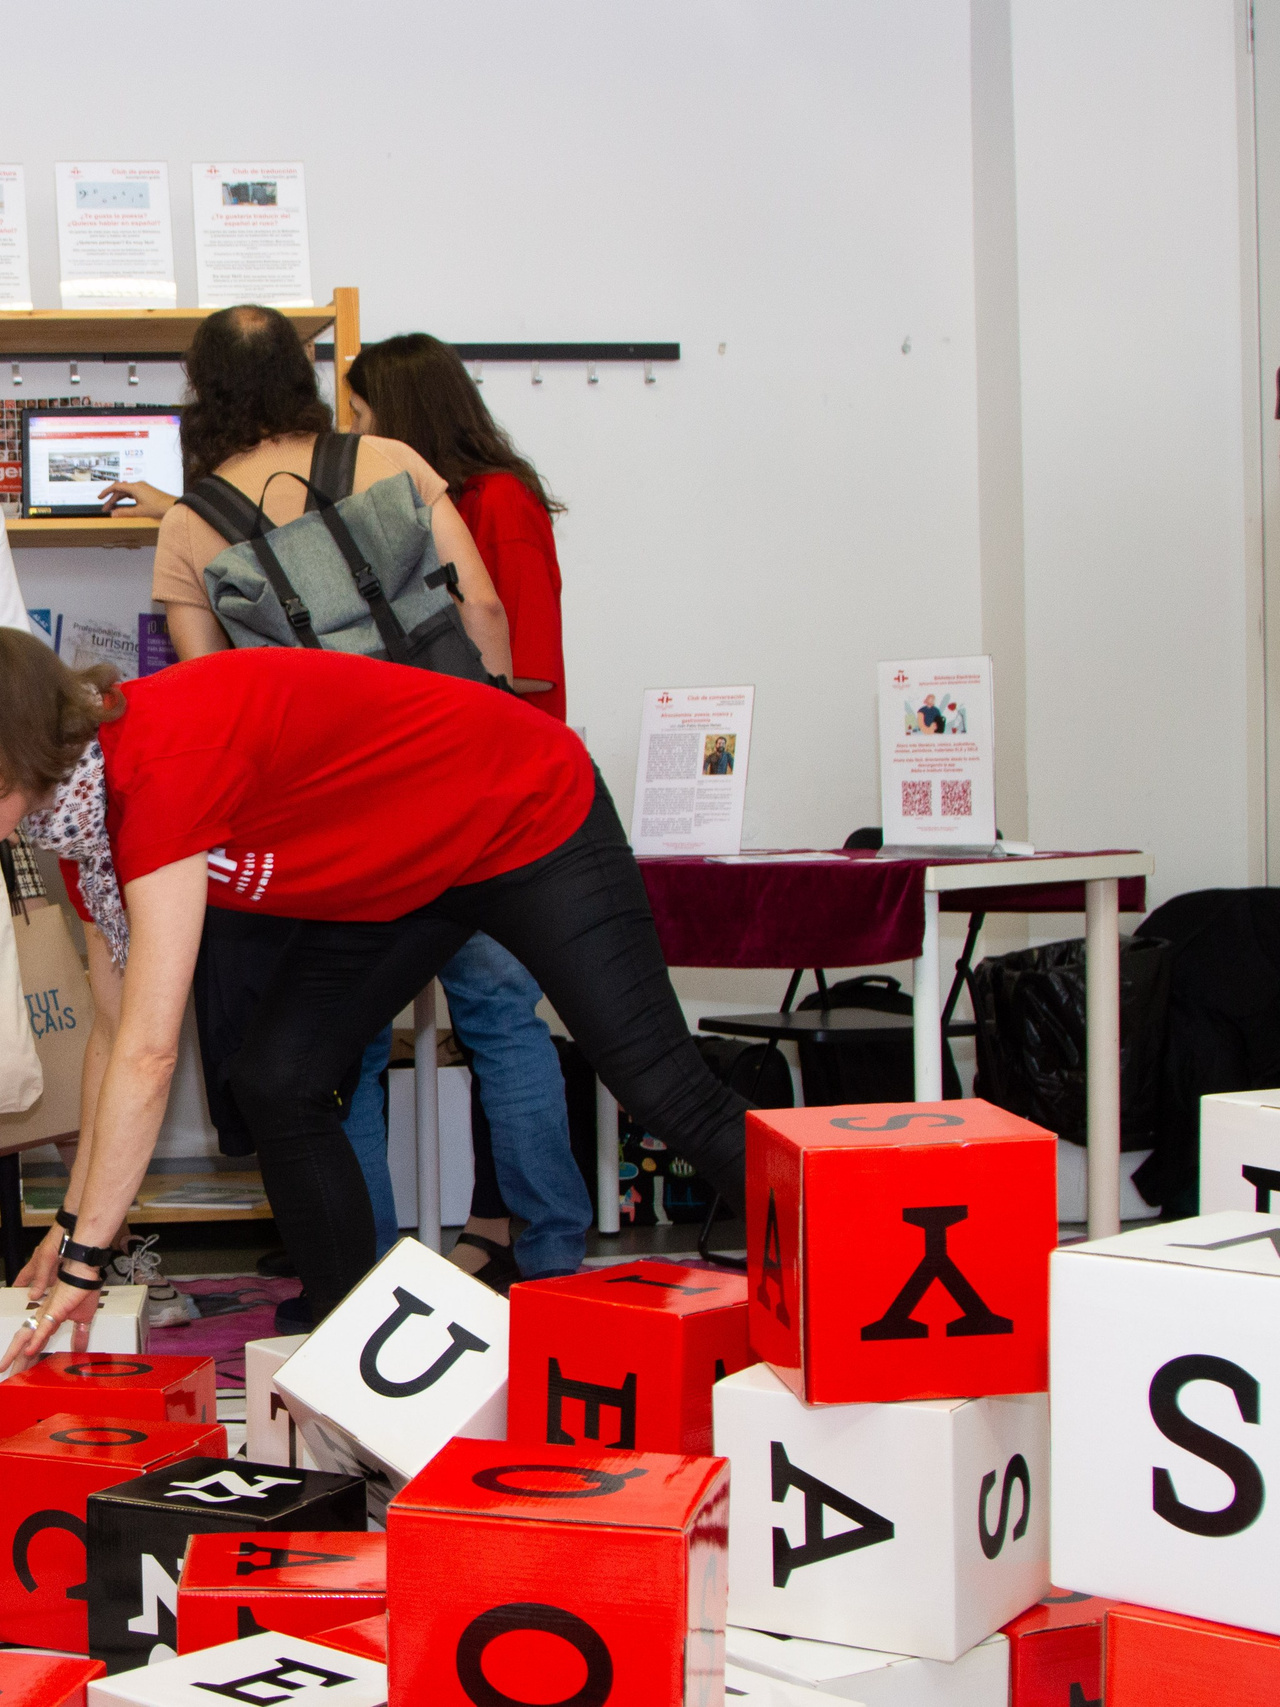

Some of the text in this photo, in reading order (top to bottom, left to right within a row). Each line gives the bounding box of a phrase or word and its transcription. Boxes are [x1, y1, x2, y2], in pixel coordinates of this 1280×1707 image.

[829, 1113, 966, 1132] S
[757, 1186, 791, 1331] A
[860, 1204, 1014, 1342] Y
[64, 1361, 154, 1378] O
[359, 1285, 491, 1398] U
[49, 1426, 149, 1447] O
[546, 1356, 638, 1451] E
[1148, 1353, 1267, 1538] S
[472, 1464, 650, 1499] Q
[770, 1440, 895, 1589] A
[978, 1453, 1031, 1560] S
[236, 1541, 357, 1576] A
[190, 1657, 358, 1707] E
[456, 1602, 614, 1707] O
